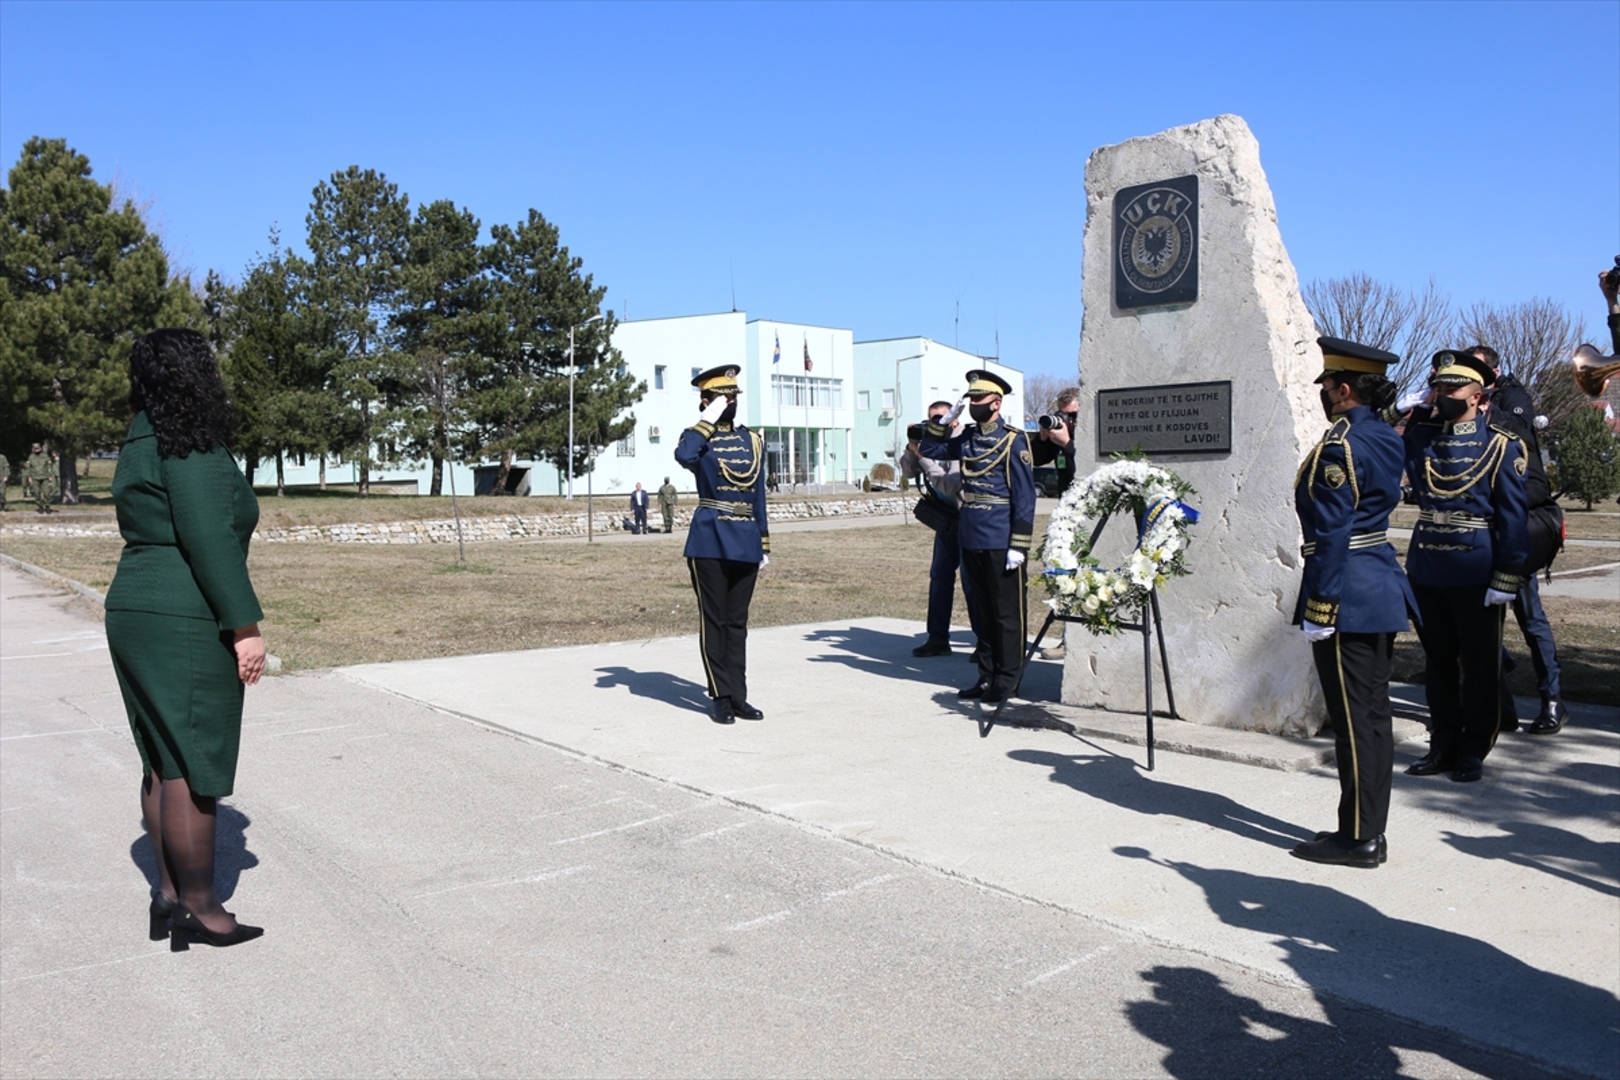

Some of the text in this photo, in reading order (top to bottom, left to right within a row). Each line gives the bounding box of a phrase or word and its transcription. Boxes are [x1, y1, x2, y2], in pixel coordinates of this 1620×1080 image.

[1127, 193, 1182, 222] UÇK
[1108, 392, 1219, 407] NE NDERIM TE TE GJITHE
[1108, 408, 1199, 420] ATYRE QE U FLIJUAN
[1107, 422, 1209, 434] PER LIRINE E KOSOVES
[1184, 433, 1220, 443] LAVDI!
